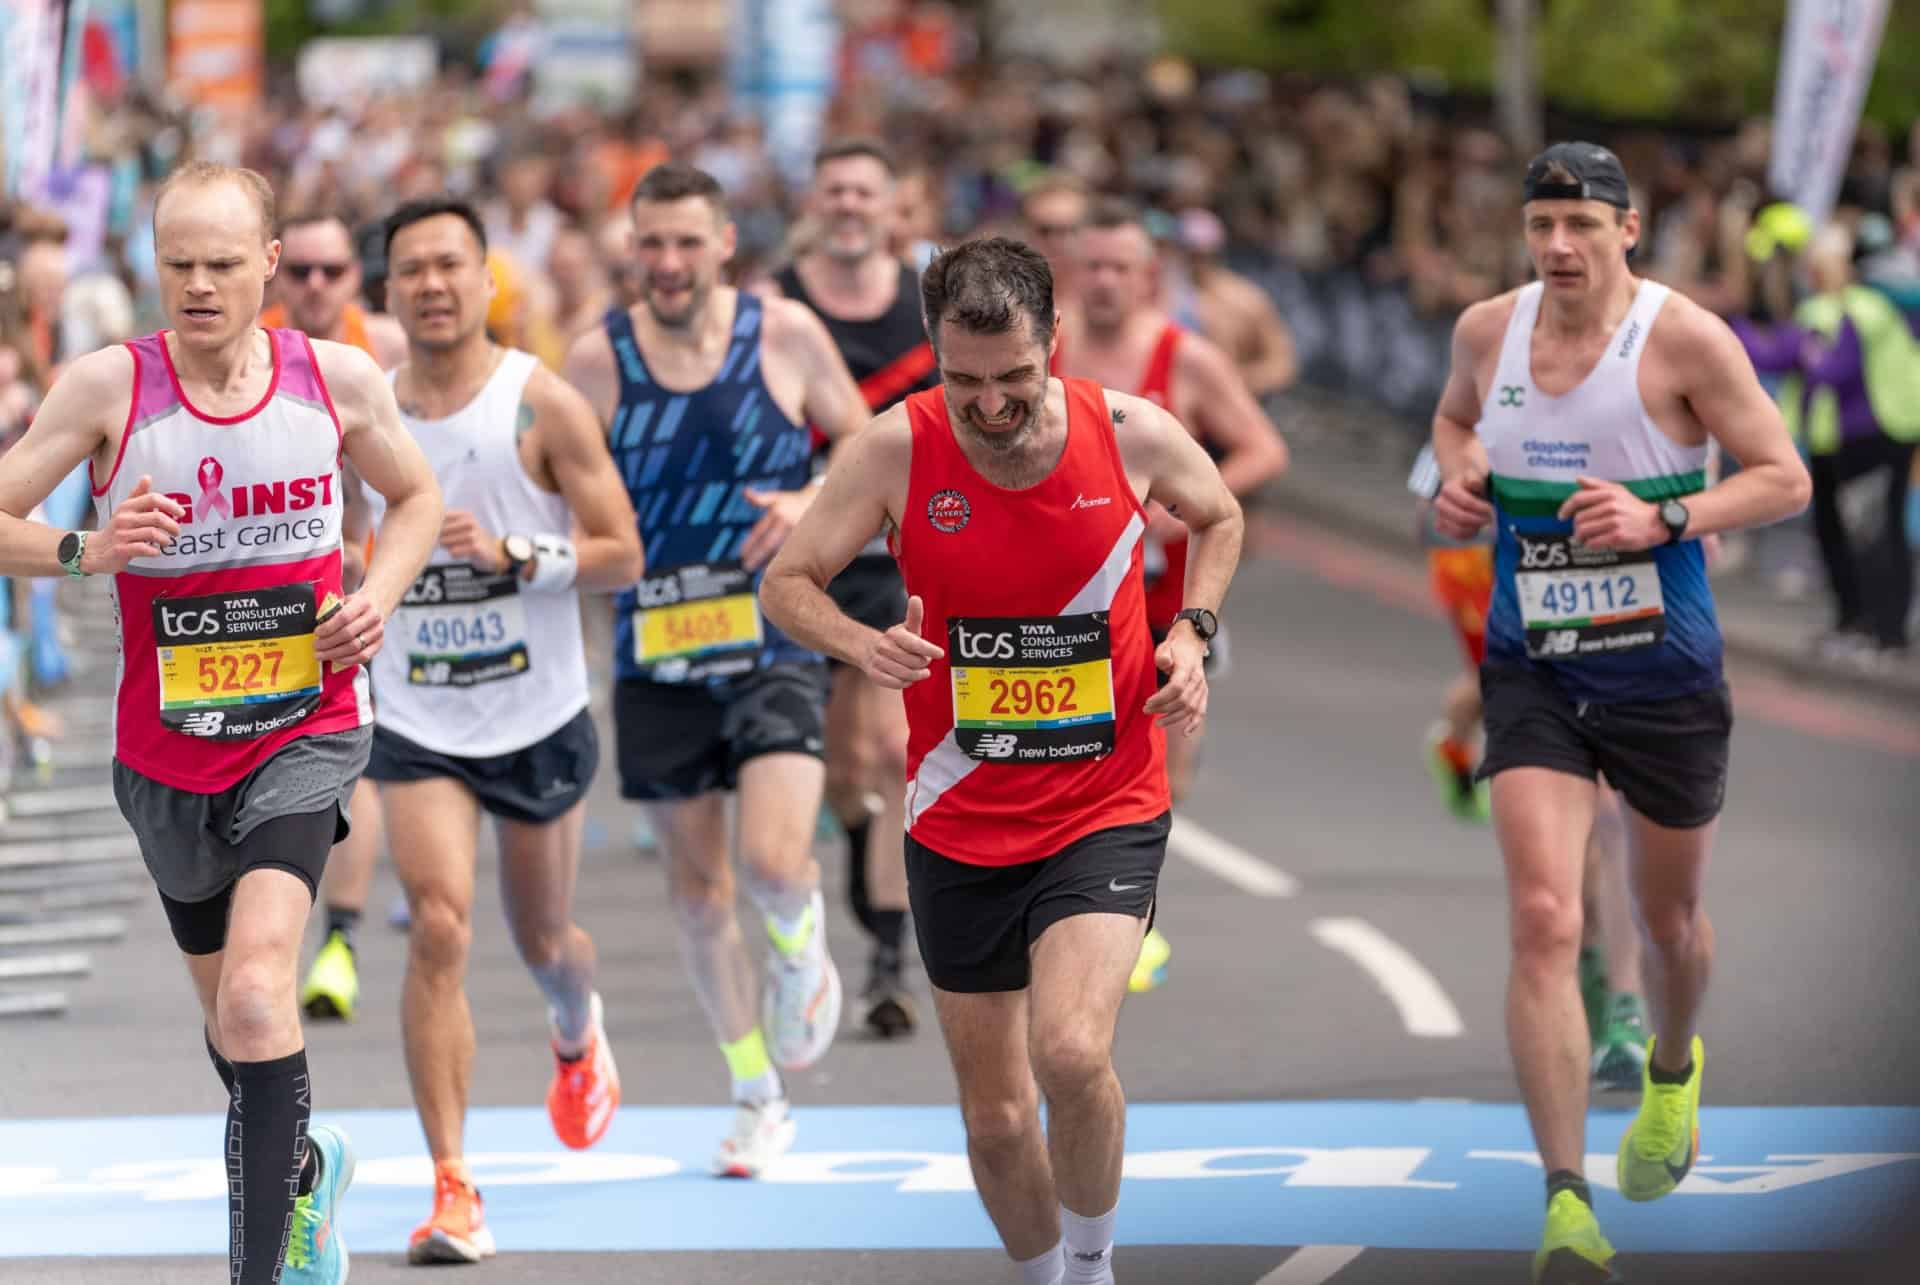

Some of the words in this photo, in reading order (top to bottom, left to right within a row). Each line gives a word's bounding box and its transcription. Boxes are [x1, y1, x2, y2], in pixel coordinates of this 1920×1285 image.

[161, 527, 227, 557] east
[237, 517, 325, 547] cance
[224, 598, 259, 609] TATA
[1541, 575, 1639, 614] 49112
[162, 605, 220, 637] tcs
[225, 602, 306, 622] CONSULTANCY
[226, 619, 279, 634] SERVICES
[417, 610, 506, 649] 49043
[1019, 624, 1056, 635] TATA
[958, 625, 1015, 659] tcs
[1020, 631, 1101, 647] CONSULTANCY
[1021, 647, 1073, 660] SERVICES
[198, 650, 284, 693] 5227
[989, 676, 1078, 715] 2962
[226, 723, 253, 736] new
[1018, 747, 1047, 759] new
[1049, 741, 1103, 758] balance
